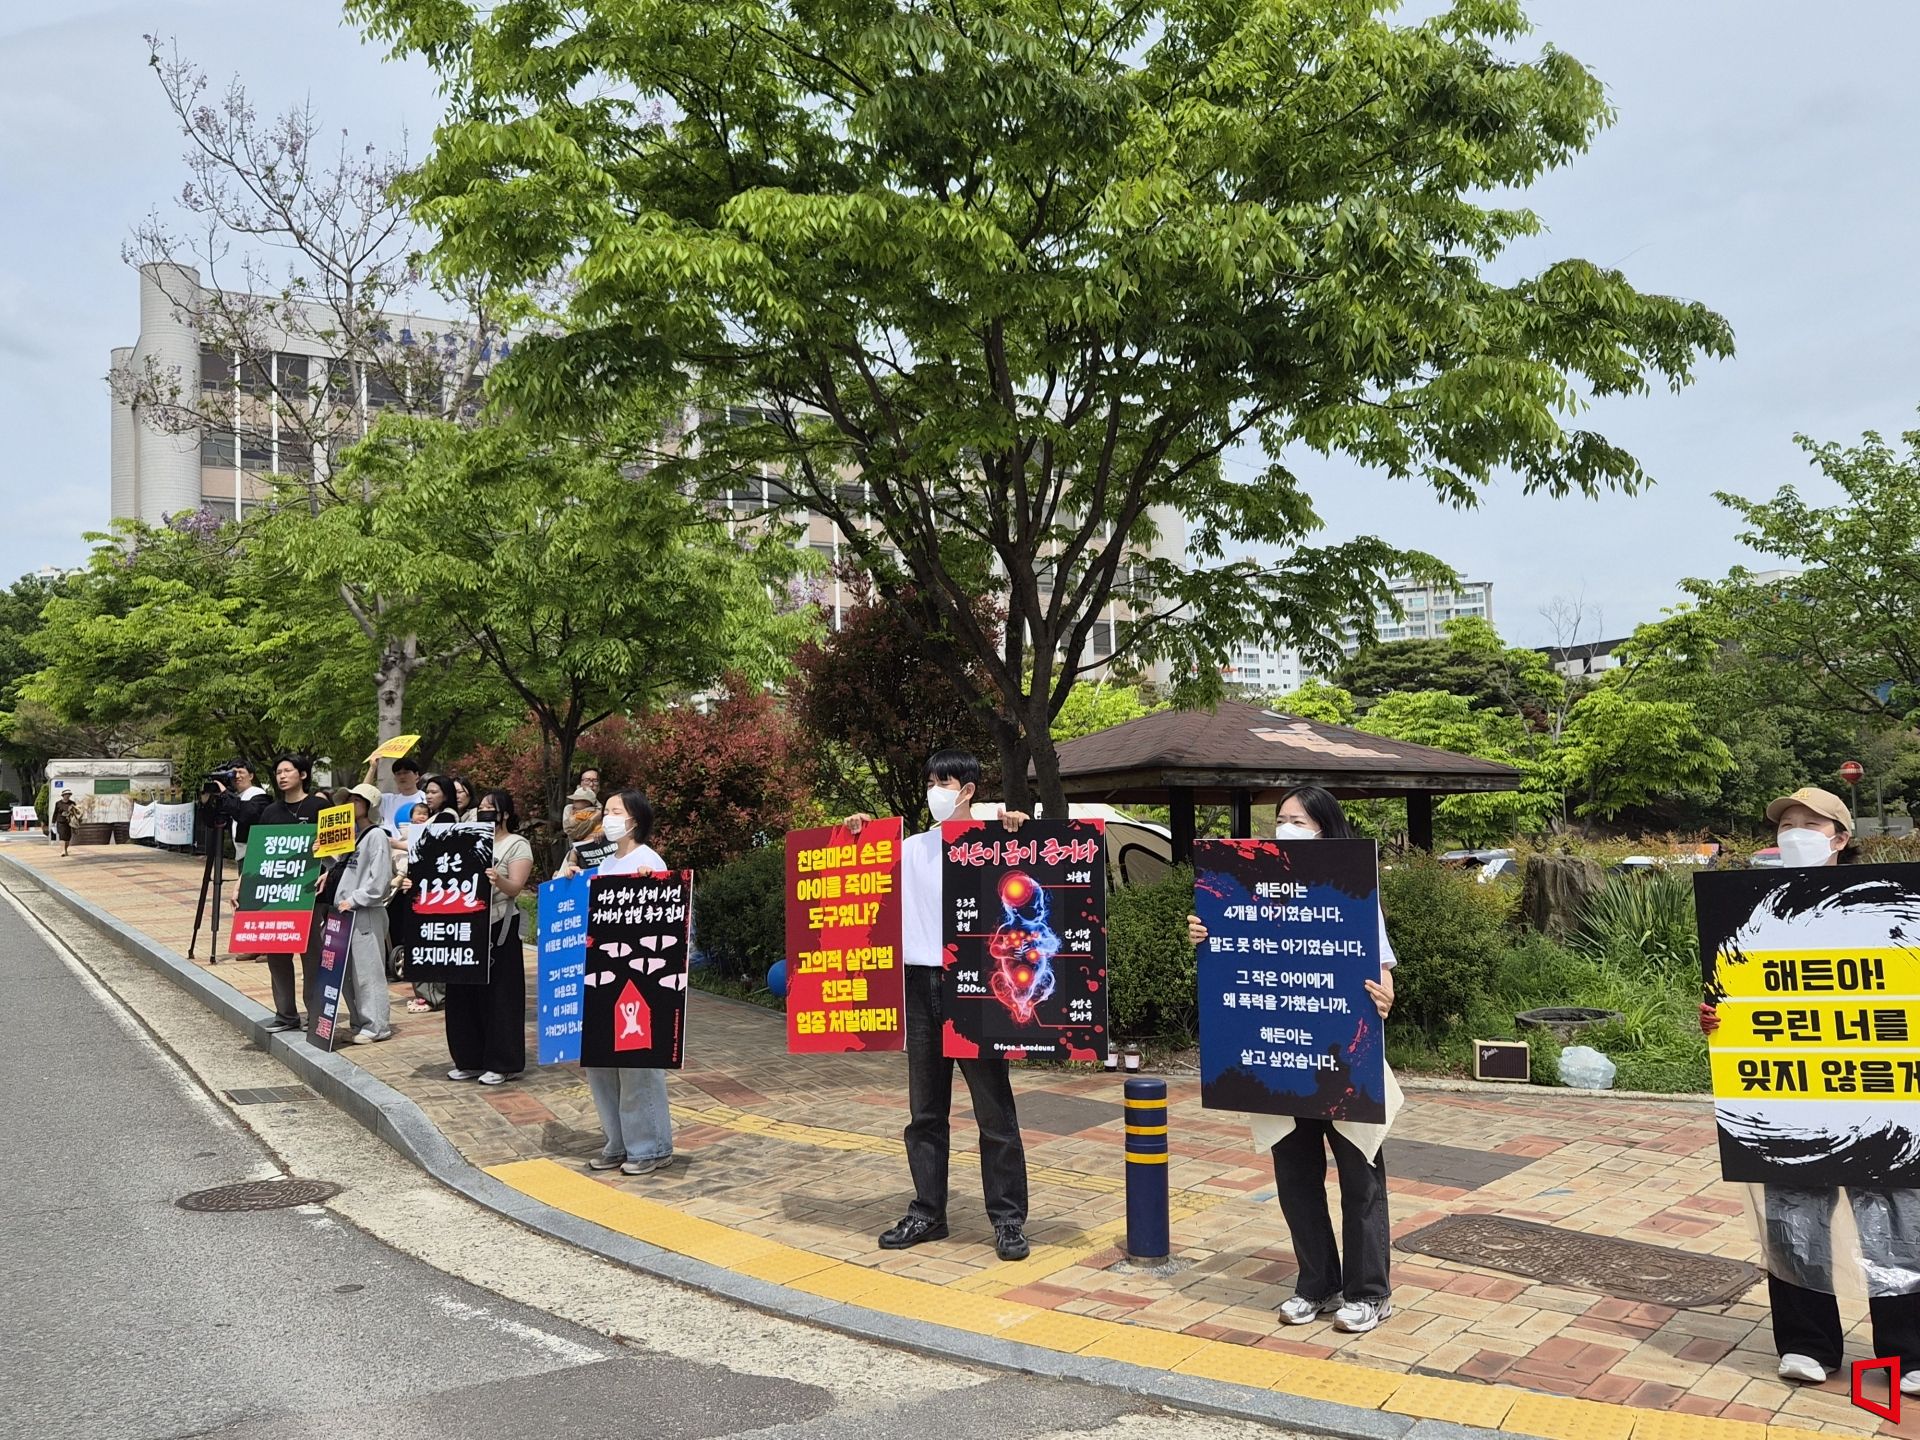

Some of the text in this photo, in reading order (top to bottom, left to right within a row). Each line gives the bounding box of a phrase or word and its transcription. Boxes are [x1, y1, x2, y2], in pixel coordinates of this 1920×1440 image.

[320, 811, 351, 828] 아동학대
[264, 836, 310, 854] 정인아!
[319, 827, 351, 845] 엄벌하라
[797, 840, 892, 872] 친엄마의 손은
[947, 837, 1099, 867] 해든이 몸이 증거다
[260, 860, 306, 878] 해든아!
[435, 852, 463, 873] 짧은
[797, 871, 892, 901] 아이를 죽이는
[1066, 871, 1091, 883] 뇌출혈
[255, 884, 302, 902] 미안해!
[419, 873, 479, 907] 133일
[597, 885, 682, 905] 여수 영아 살해 사건
[1255, 882, 1308, 898] 해든이는
[557, 899, 575, 914] 우리는
[956, 897, 976, 908] 23곳
[592, 904, 686, 924] 가해자 엄벌 촉구 집회
[808, 902, 880, 929] 도구였나?
[955, 909, 979, 920] 갈비뼈
[1224, 905, 1344, 923] 4개월 아기였습니다.
[420, 922, 472, 941] 해든이를
[956, 921, 971, 932] 골절
[258, 933, 276, 941] 우리가
[1209, 937, 1366, 957] 말도 못 하는 아기였습니다.
[412, 947, 480, 966] 잊지마세요.
[797, 945, 893, 974] 고의적 살인범
[956, 970, 979, 982] 복막혈
[1236, 971, 1334, 989] 그 작은 아이에게
[1762, 958, 1885, 992] 해든아!
[554, 983, 578, 999] 마음으로
[821, 978, 868, 1003] 친모를
[957, 983, 987, 993] 500cc
[553, 1002, 578, 1018] 이 자리를
[1070, 999, 1092, 1010] 수많은
[1223, 993, 1351, 1014] 왜 폭력을 가했습니까.
[797, 1007, 898, 1034] 엄중 처벌해라!
[1069, 1011, 1092, 1022] 멍자국
[1752, 1009, 1909, 1042] 우린 너를
[1260, 1026, 1313, 1046] 해든이는
[1240, 1049, 1339, 1072] 살고 싶었습니다.
[1737, 1059, 1809, 1092] 잊지
